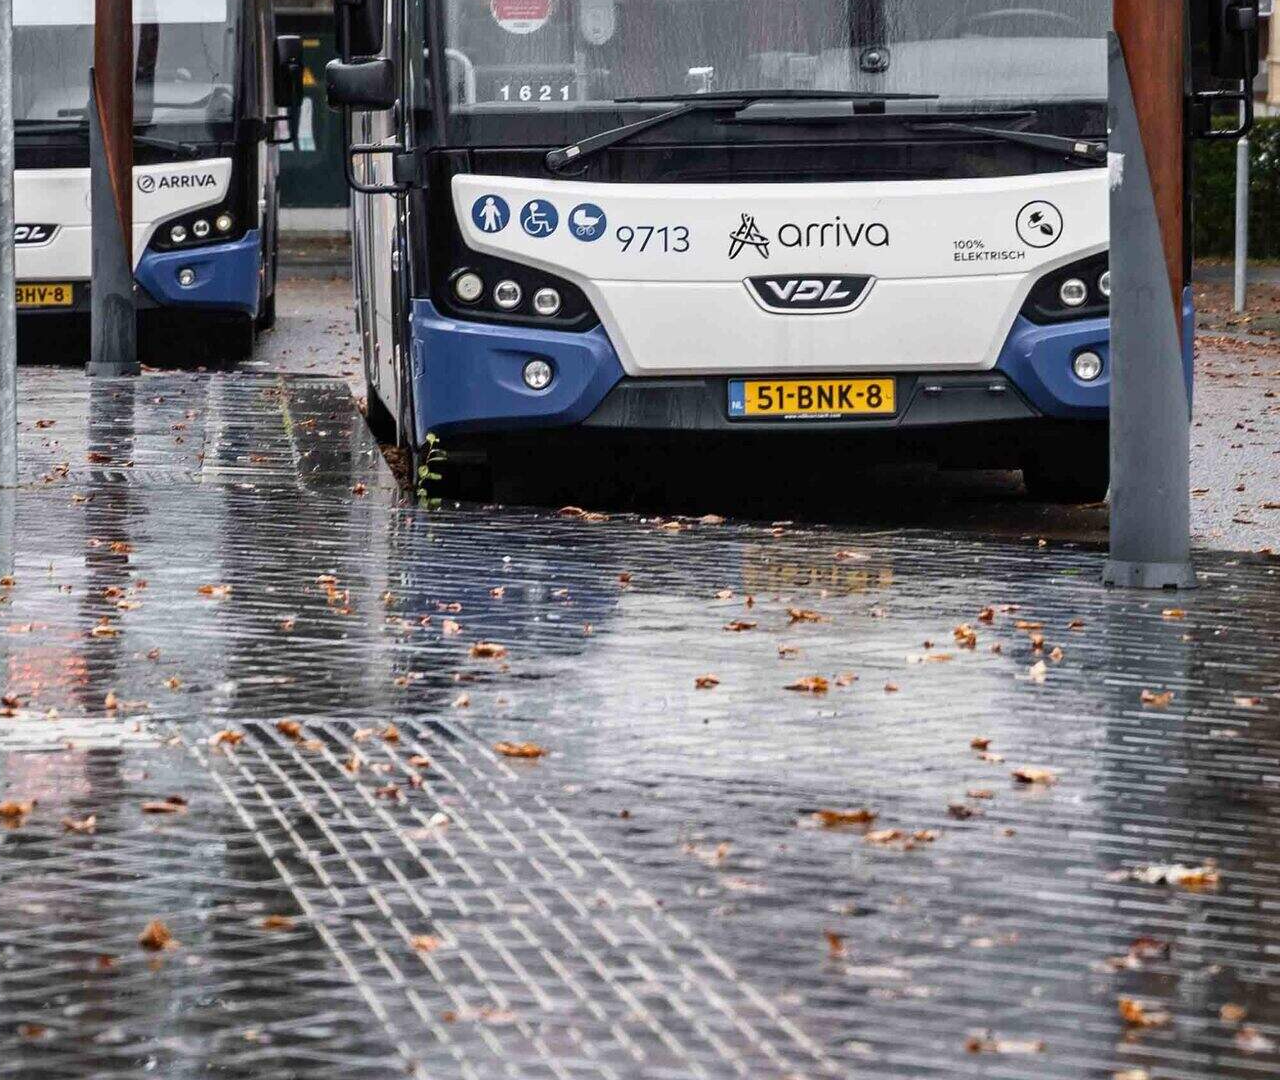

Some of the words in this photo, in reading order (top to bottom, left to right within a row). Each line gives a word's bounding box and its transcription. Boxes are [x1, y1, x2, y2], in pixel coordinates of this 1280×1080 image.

[500, 84, 570, 101] 1621
[158, 174, 217, 189] ARRIVA
[14, 226, 46, 240] DL
[615, 225, 690, 253] 9713
[777, 215, 890, 247] arriva
[953, 239, 985, 249] 100%
[953, 251, 1025, 261] ELEKTRISCH
[765, 279, 850, 302] VDL
[757, 384, 883, 410] 51-BNK-8
